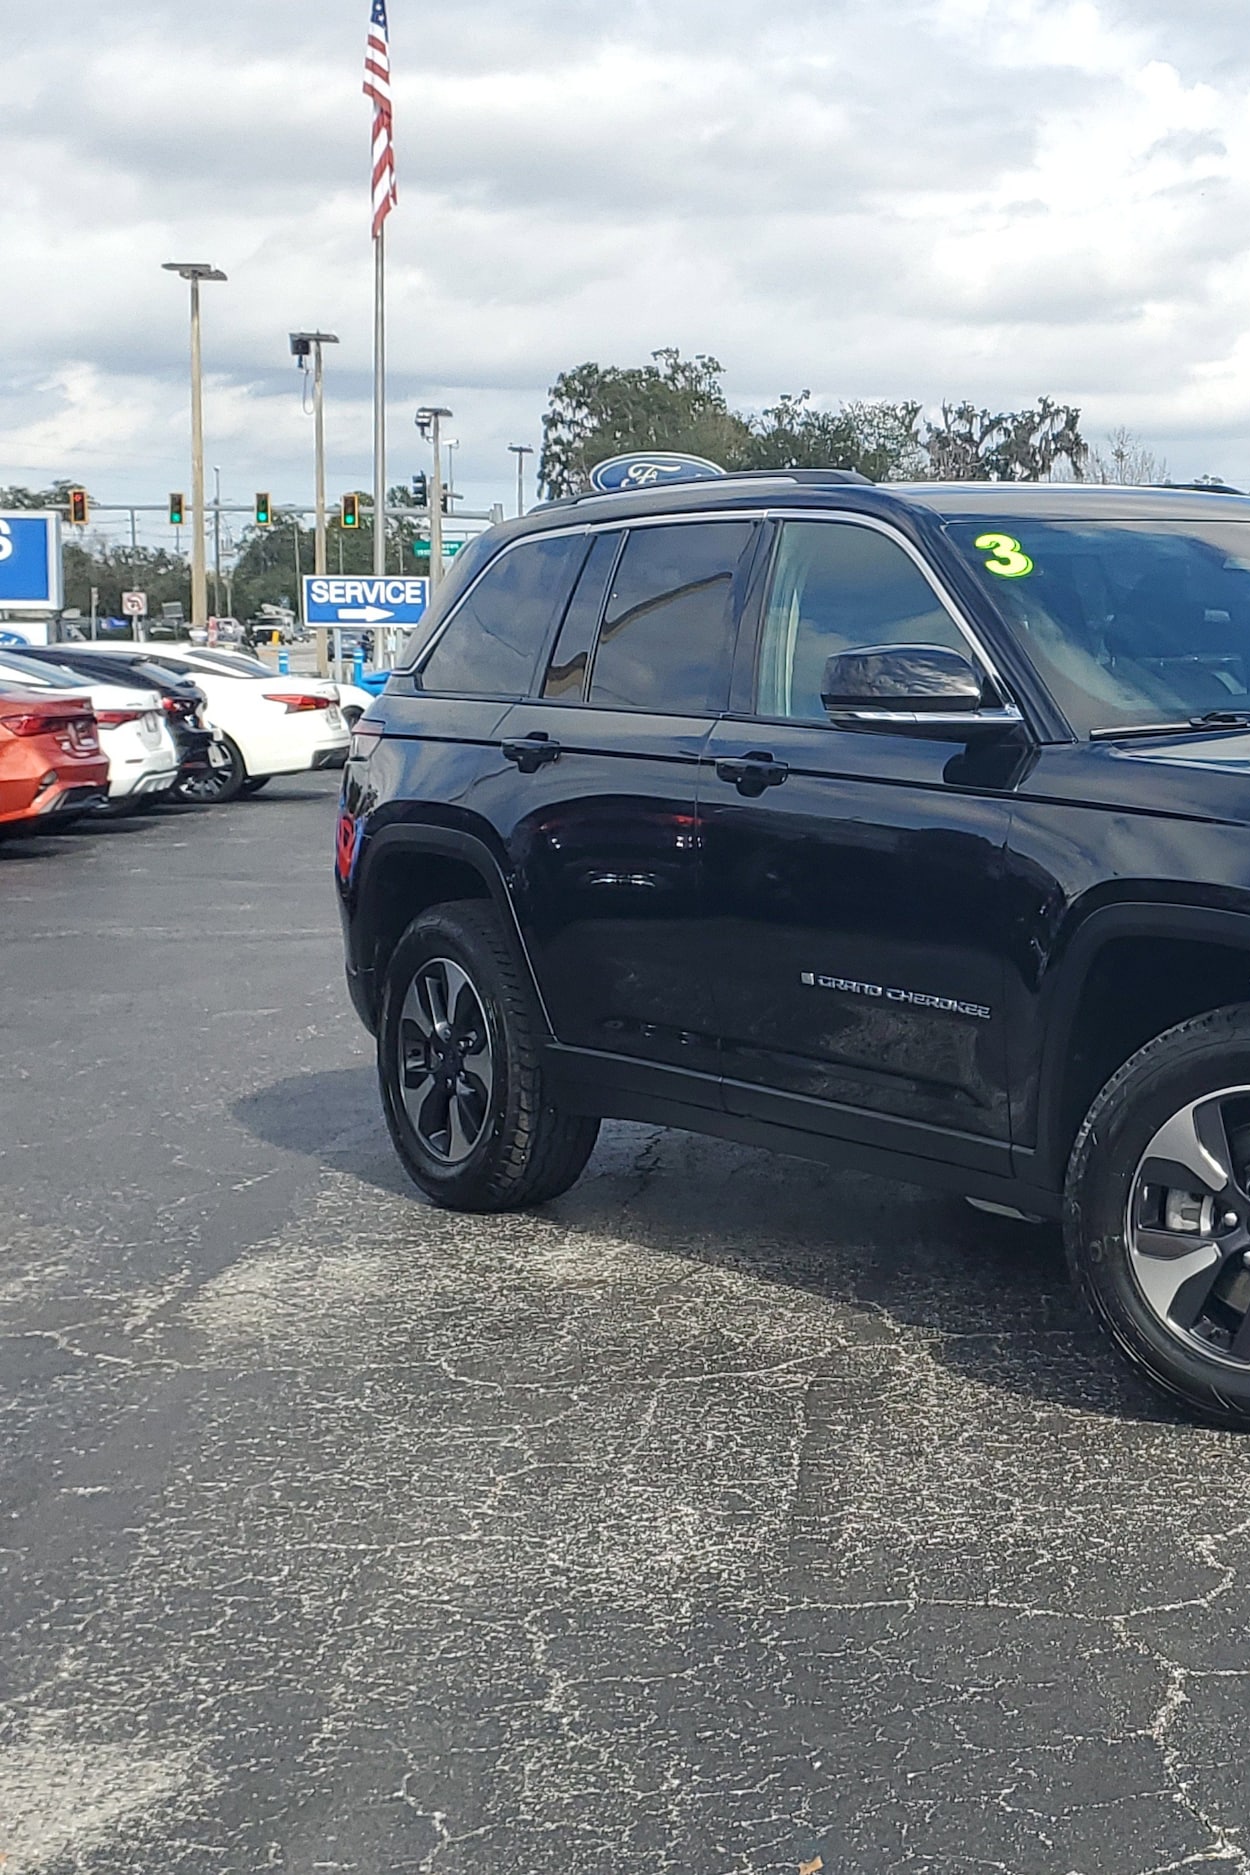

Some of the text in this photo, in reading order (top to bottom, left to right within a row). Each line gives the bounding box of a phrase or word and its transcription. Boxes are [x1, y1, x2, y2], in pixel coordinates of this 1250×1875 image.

[974, 532, 1034, 578] 3
[310, 580, 422, 604] SERVICE
[818, 974, 991, 1019] GRAND CHEROKEE
